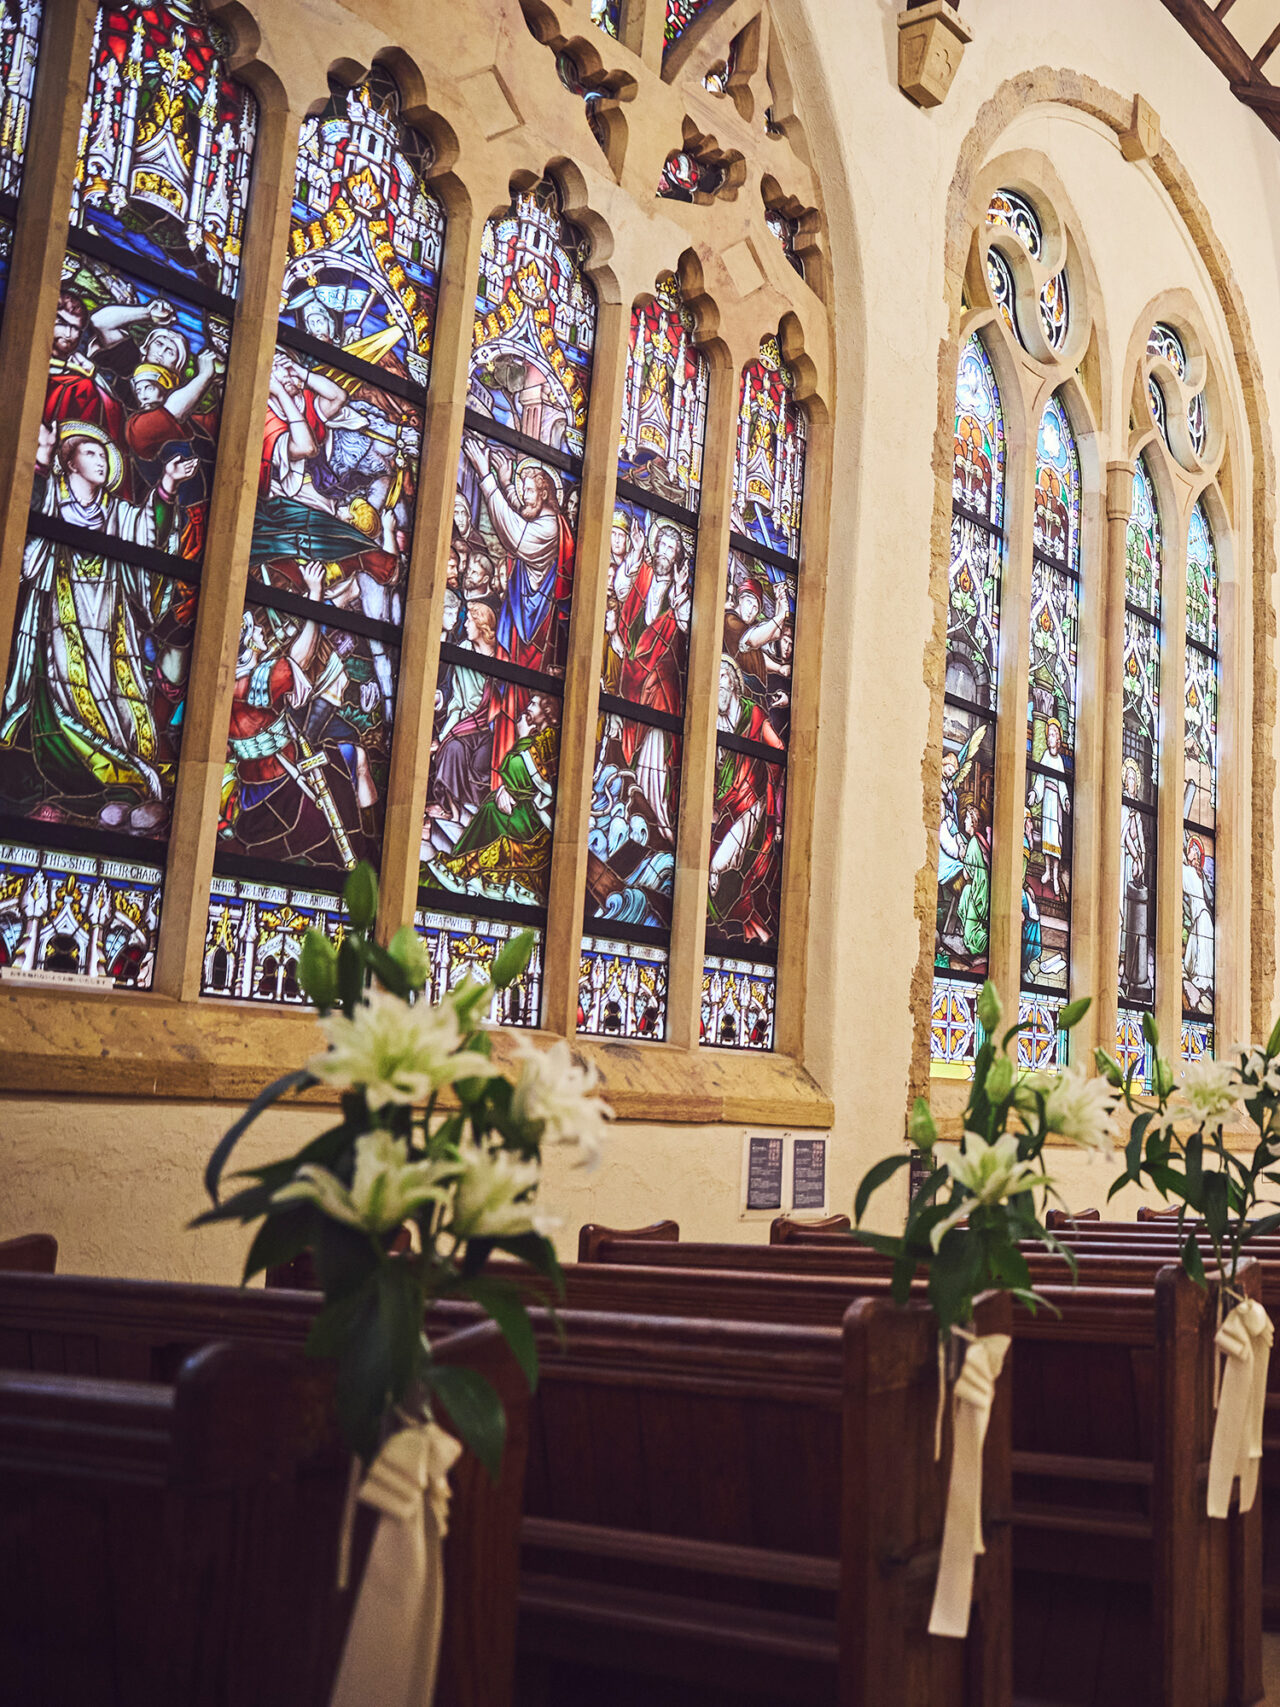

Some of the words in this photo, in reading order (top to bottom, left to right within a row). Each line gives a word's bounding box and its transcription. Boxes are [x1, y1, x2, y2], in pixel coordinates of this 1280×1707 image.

[2, 847, 19, 861] LAY
[43, 853, 67, 868] THIS
[69, 857, 85, 870] SIN
[101, 862, 128, 877] THEIR
[212, 880, 220, 891] IN
[253, 886, 270, 899] LIVE
[425, 914, 446, 927] WHAT
